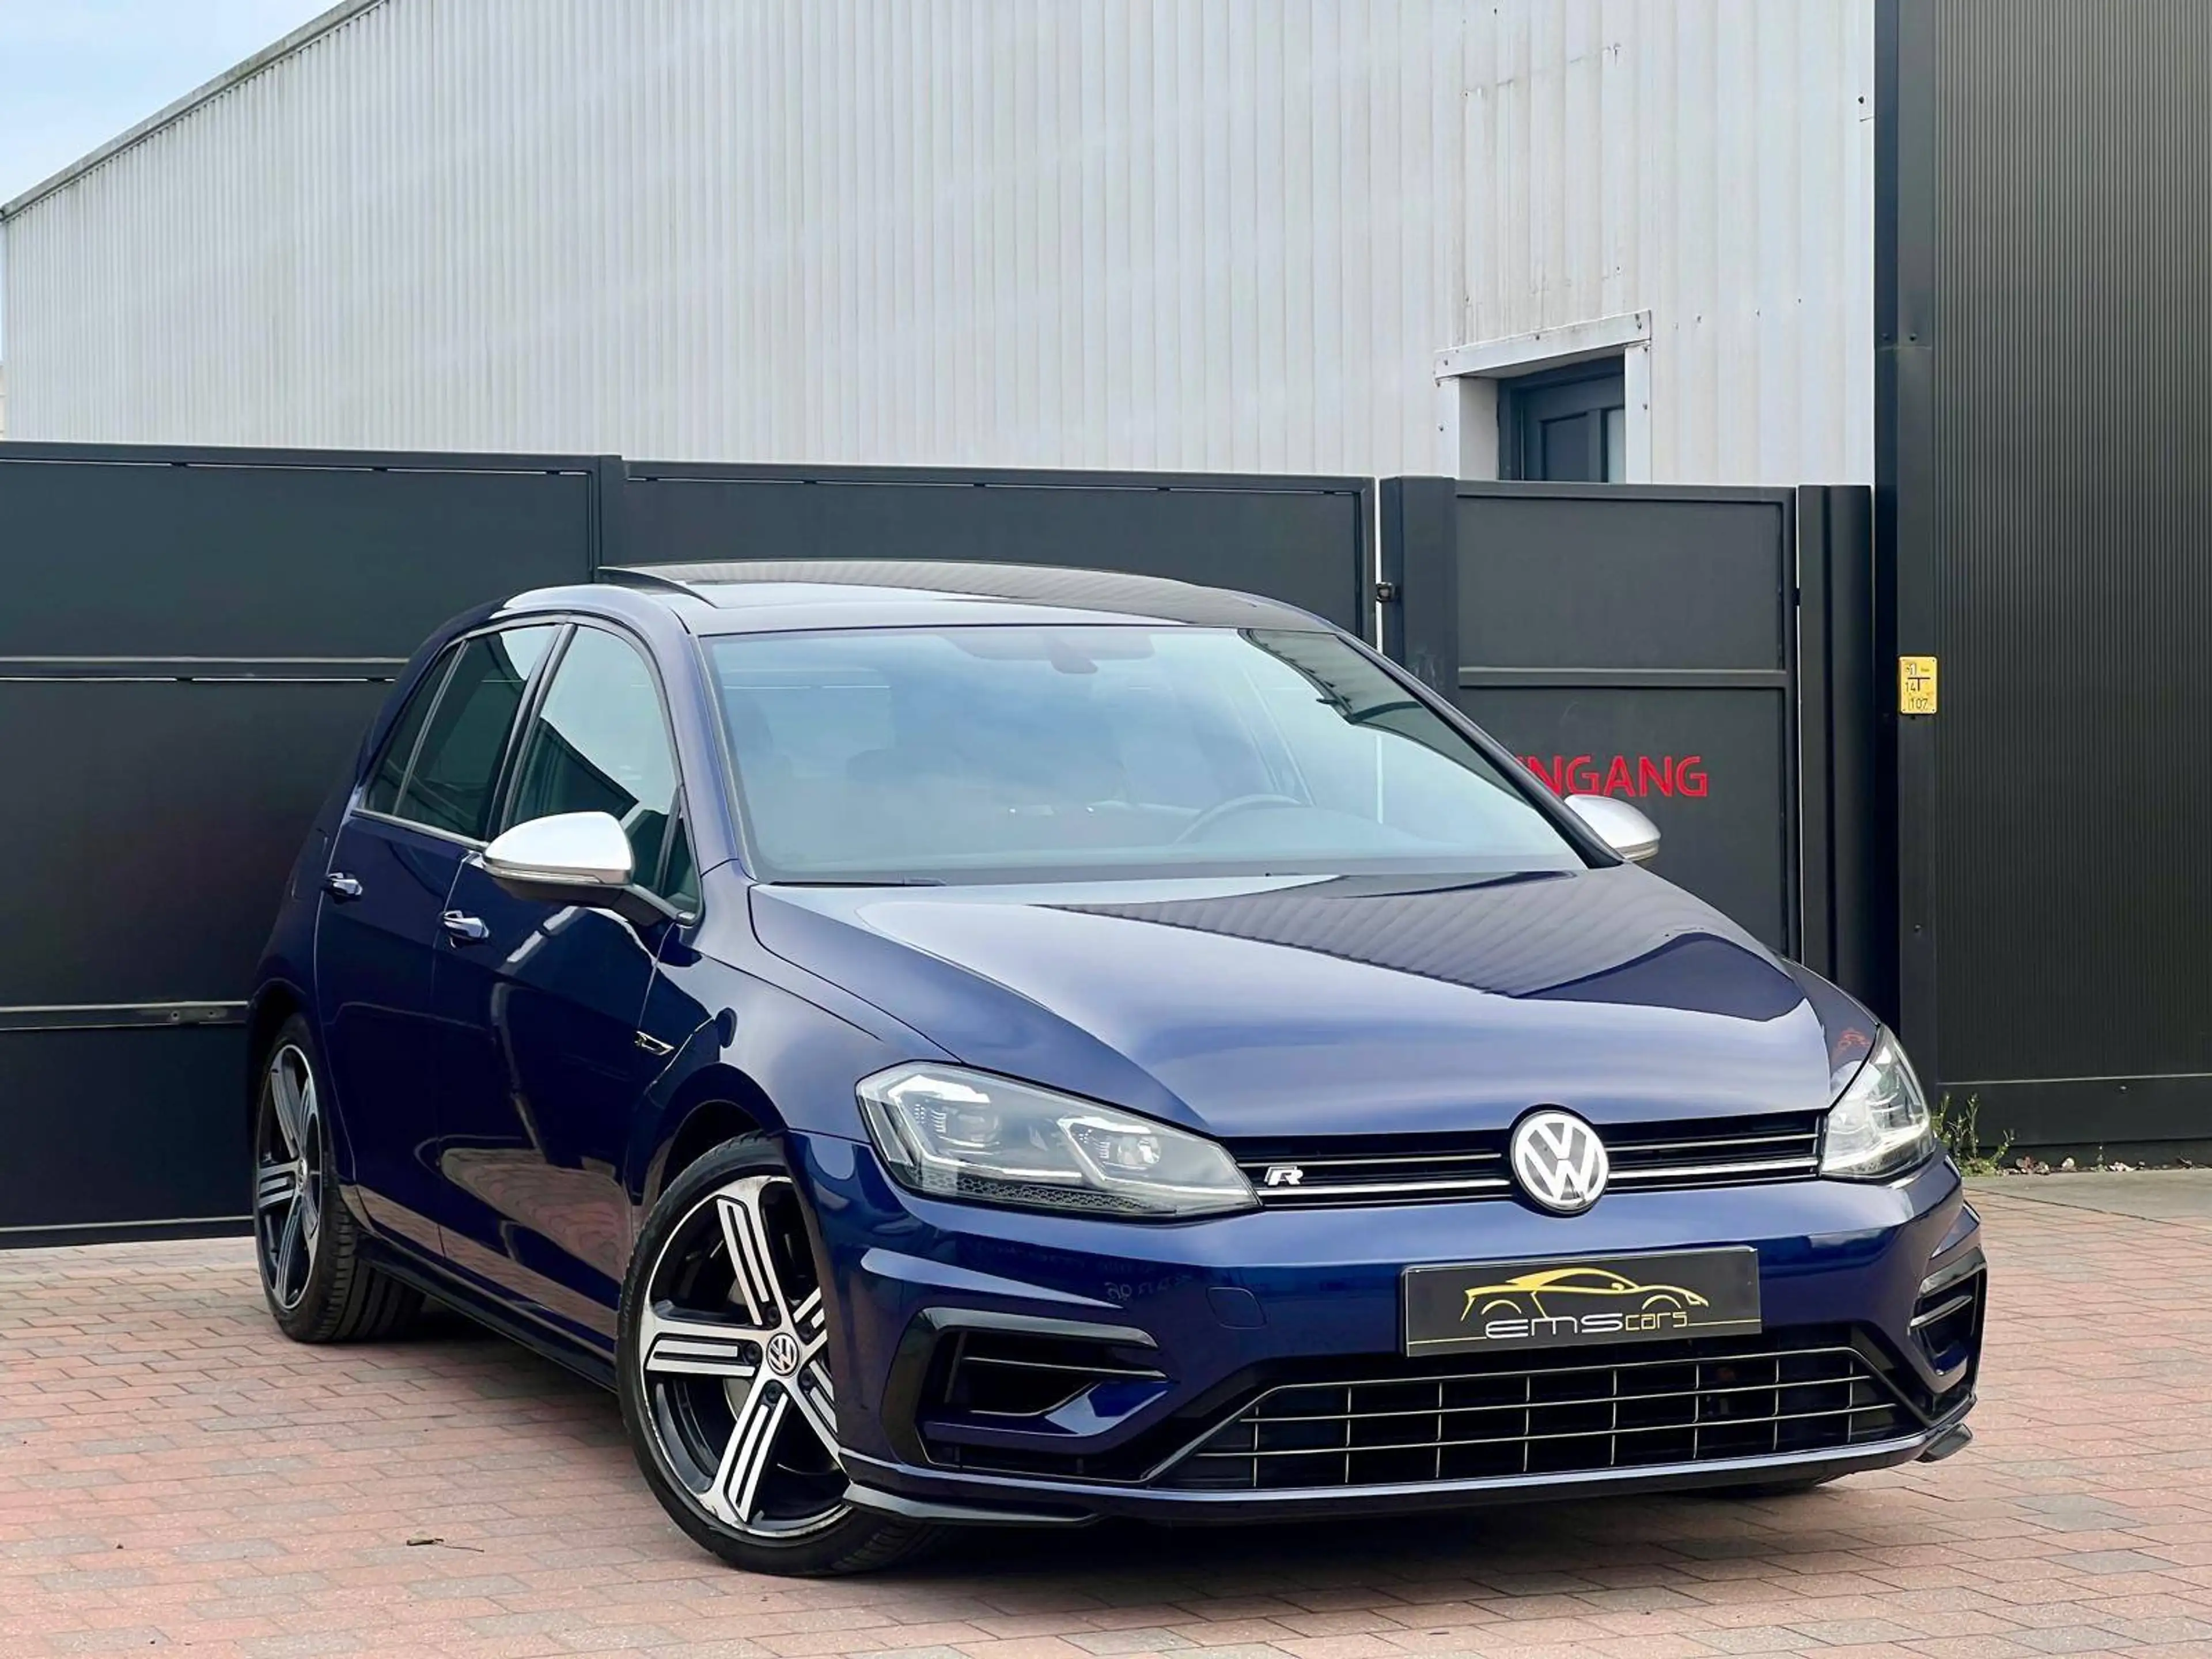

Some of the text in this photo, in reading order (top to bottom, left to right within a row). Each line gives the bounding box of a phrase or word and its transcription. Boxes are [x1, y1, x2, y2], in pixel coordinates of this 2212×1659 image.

[1517, 756, 1709, 797] NGANG
[1266, 1165, 1304, 1186] R
[1517, 1116, 1605, 1207] VW
[768, 1336, 797, 1374] VW
